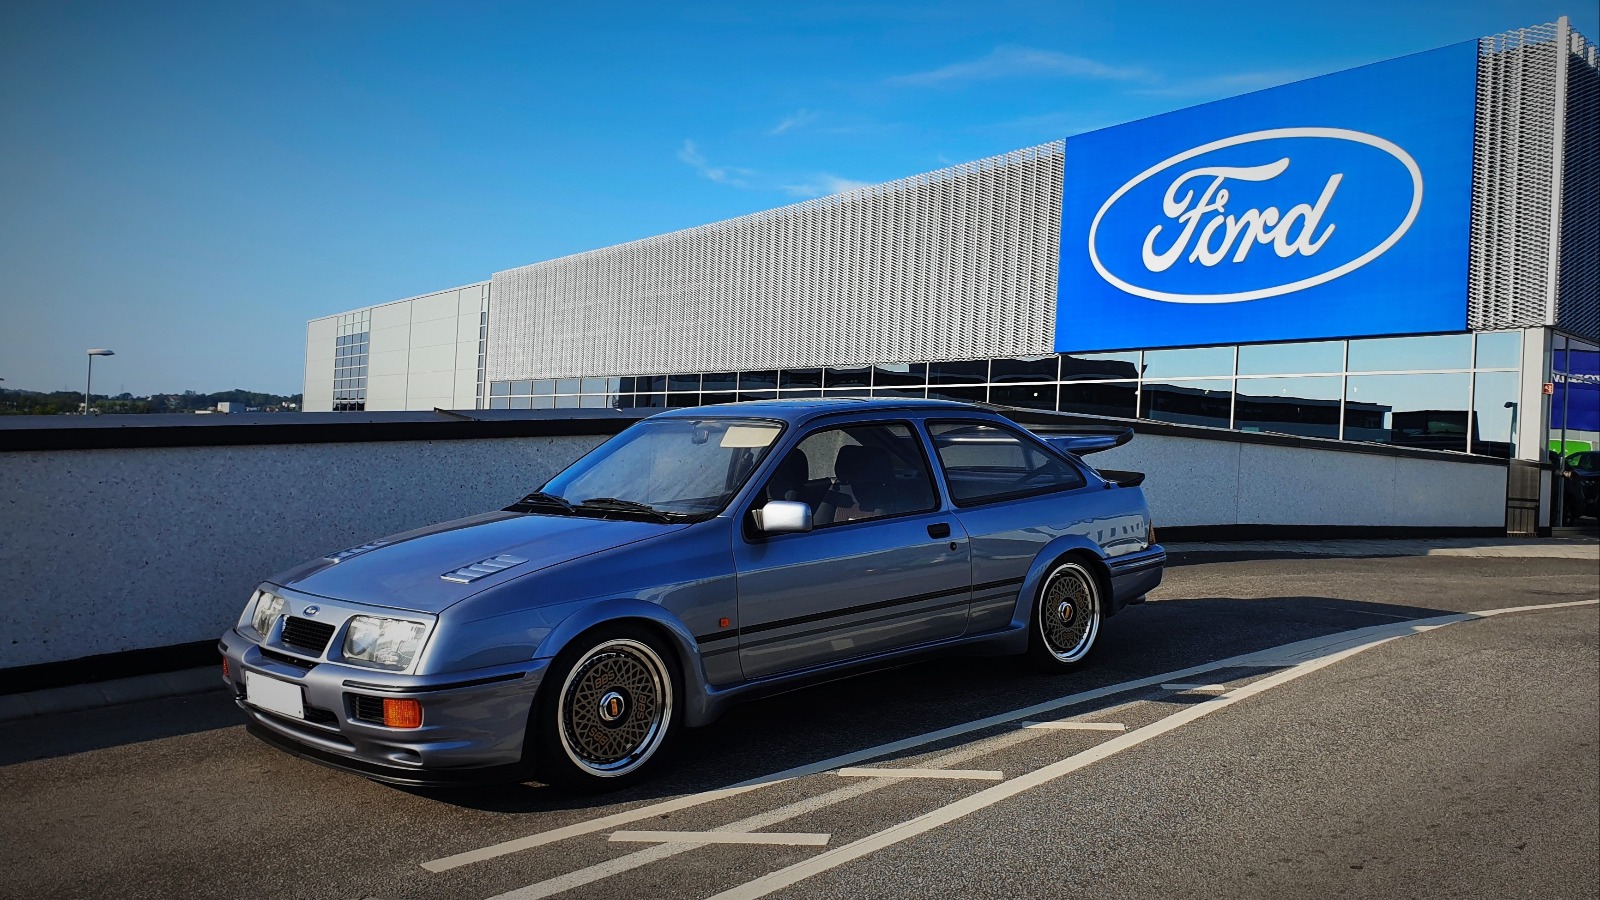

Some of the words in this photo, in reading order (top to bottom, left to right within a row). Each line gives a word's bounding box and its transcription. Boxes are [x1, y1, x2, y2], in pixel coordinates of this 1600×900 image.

[1142, 157, 1344, 272] Ford
[594, 670, 615, 689] BBS
[637, 694, 647, 719] BBS
[588, 727, 609, 746] BBS
